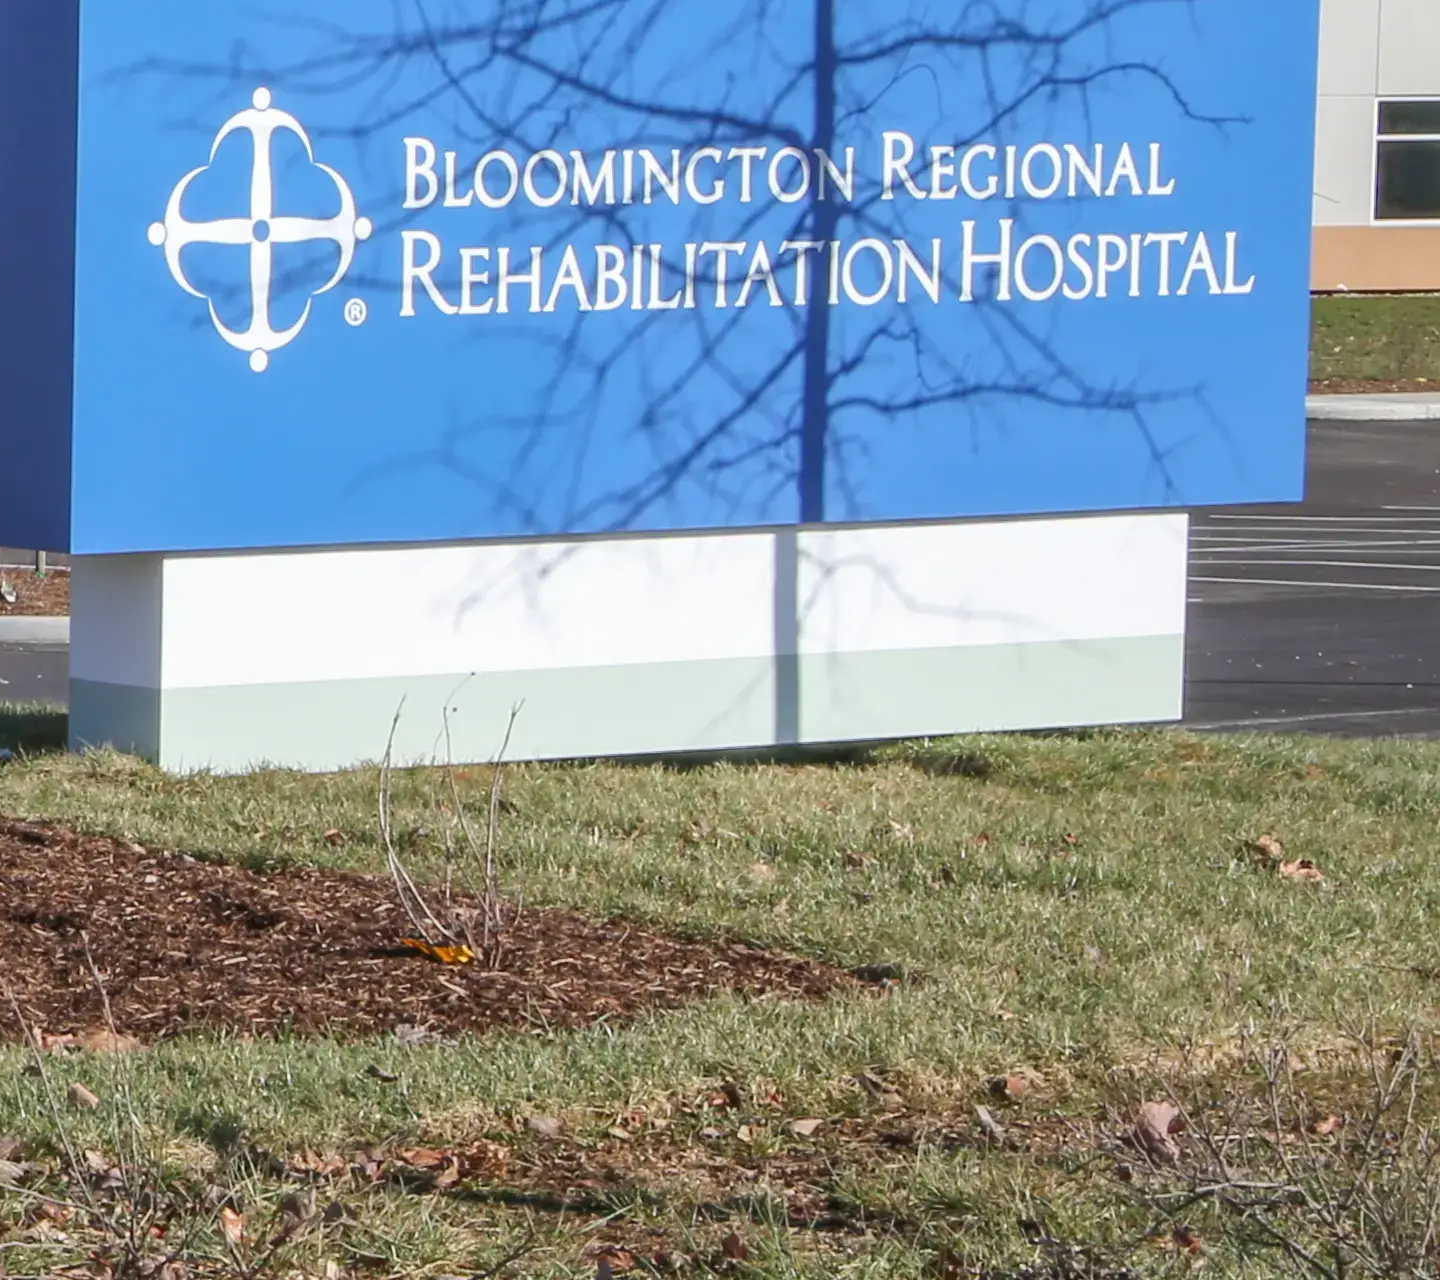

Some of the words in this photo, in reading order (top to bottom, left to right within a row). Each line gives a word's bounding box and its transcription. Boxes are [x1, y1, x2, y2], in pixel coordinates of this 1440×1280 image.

[402, 136, 856, 209] BLOOMINGTON
[881, 130, 1176, 201] REGIONAL
[399, 229, 942, 317] REHABILITATION
[958, 218, 1256, 302] HOSPITAL
